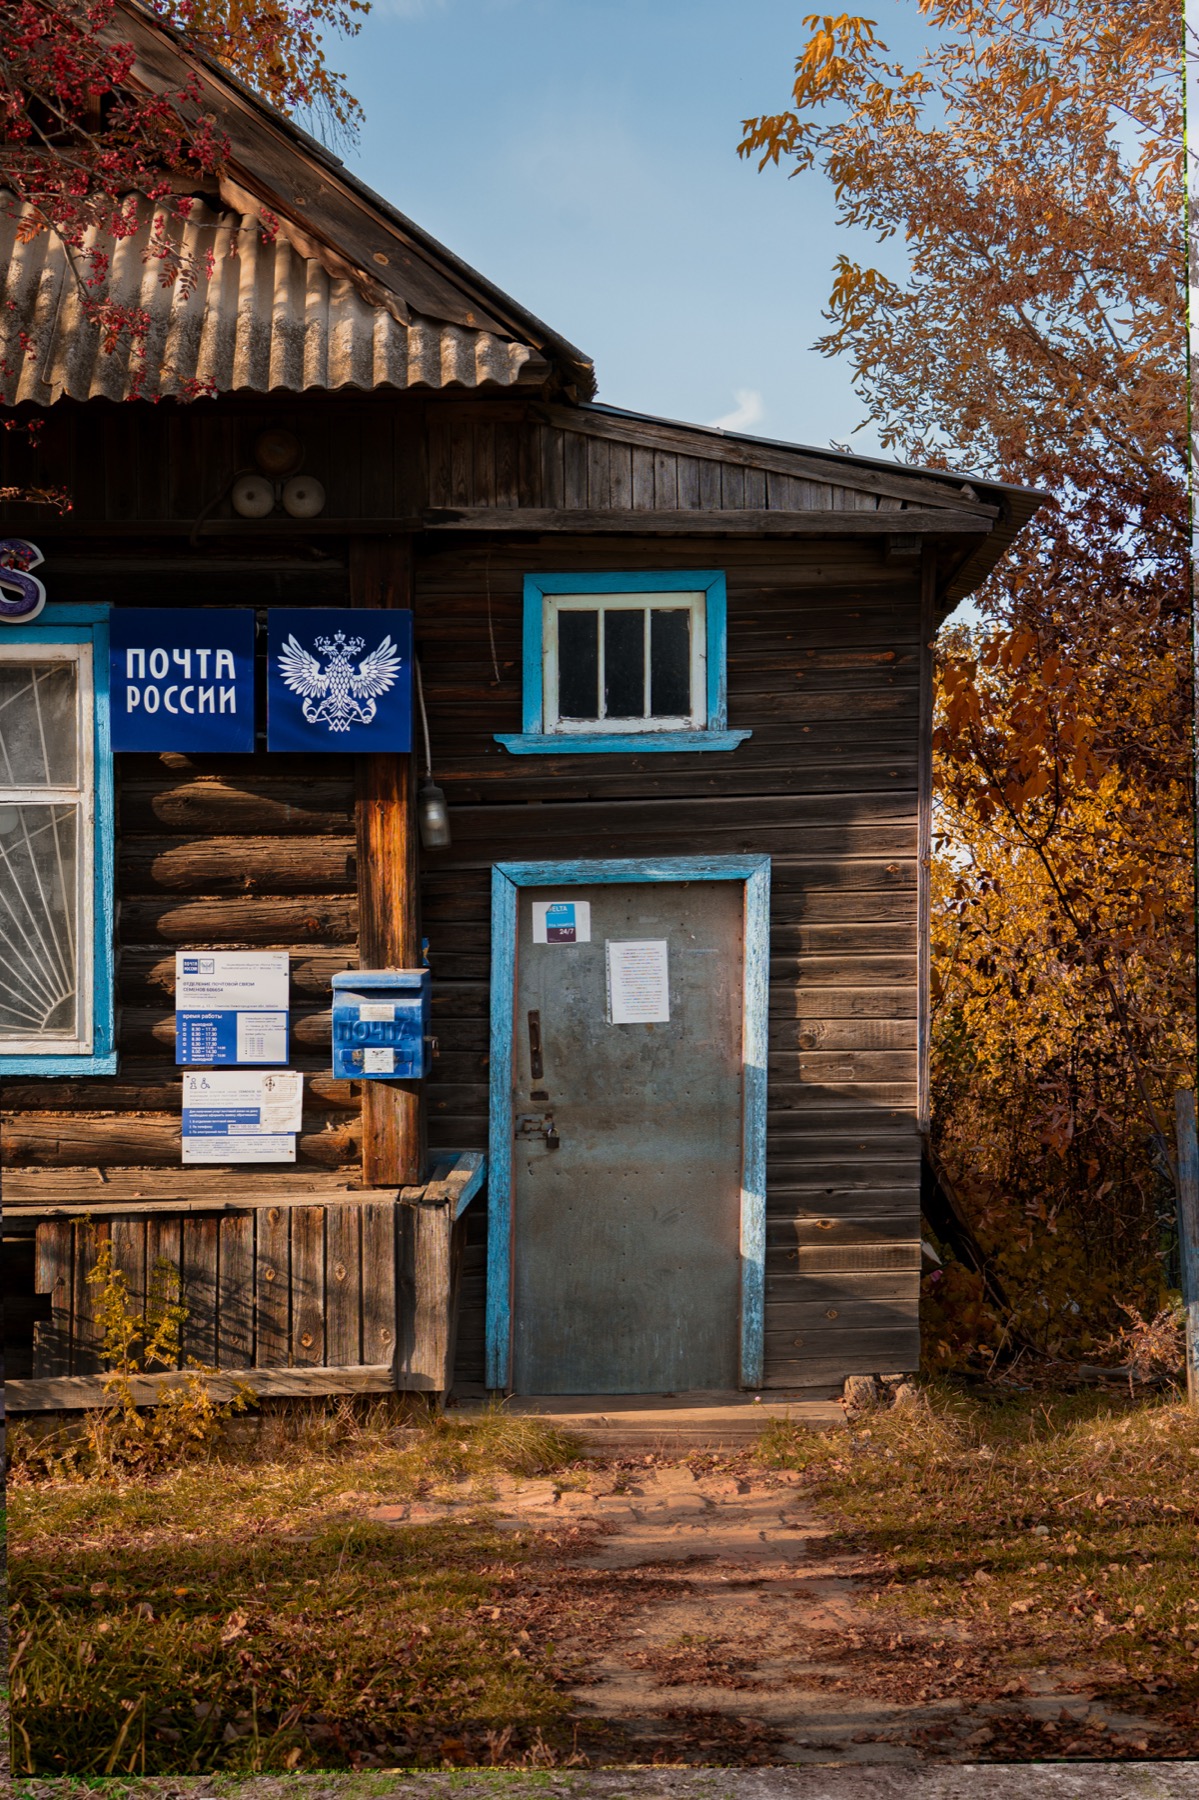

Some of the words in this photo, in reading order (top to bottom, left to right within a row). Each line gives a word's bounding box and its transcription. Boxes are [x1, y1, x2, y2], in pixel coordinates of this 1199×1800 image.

[126, 648, 236, 680] ПОЧТА
[126, 685, 237, 714] РОССИИ
[337, 1020, 416, 1041] ПОЧТА
